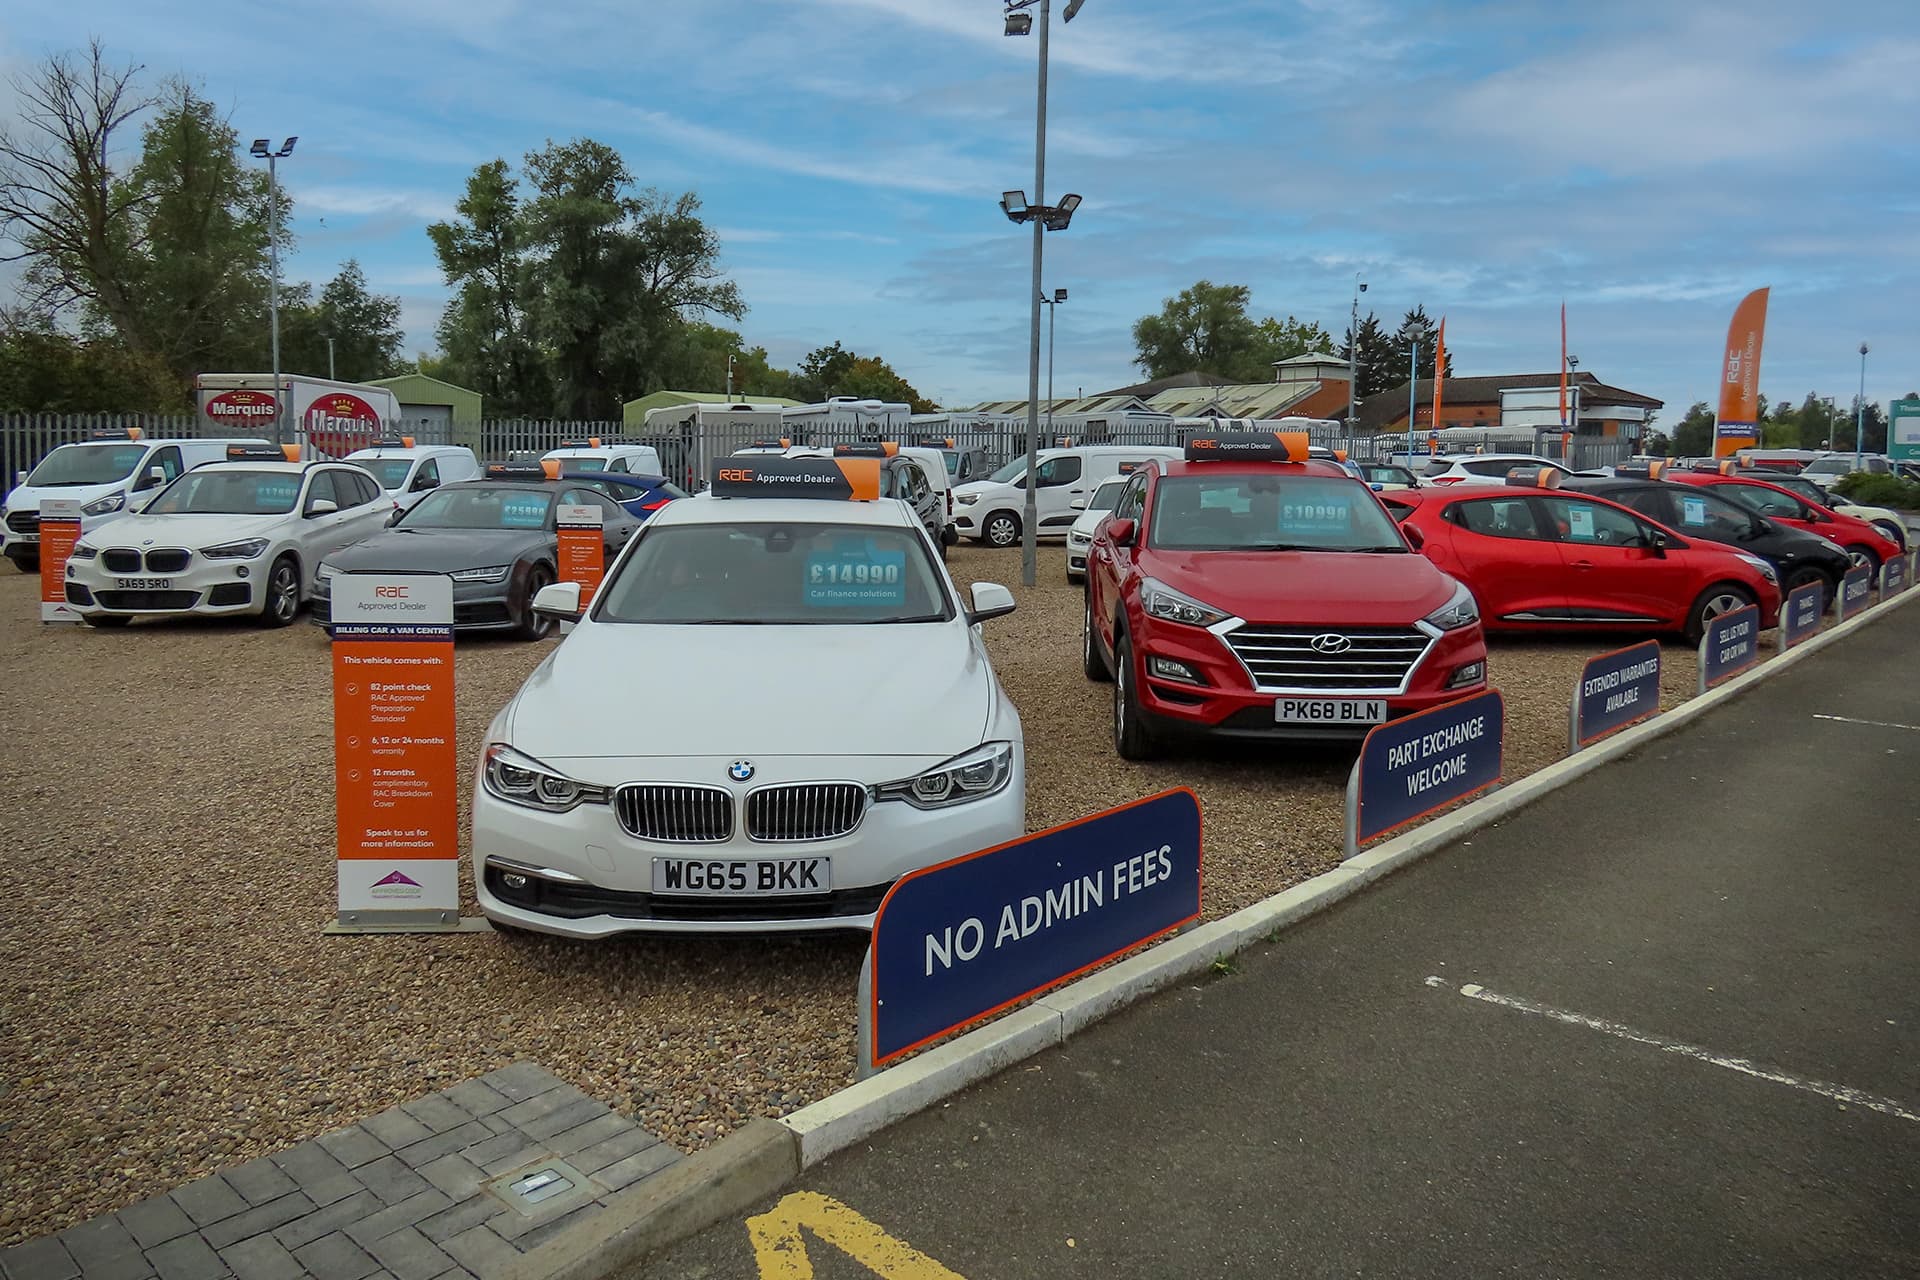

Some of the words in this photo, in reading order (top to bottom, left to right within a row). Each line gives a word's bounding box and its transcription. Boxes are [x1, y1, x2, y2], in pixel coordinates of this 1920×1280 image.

[212, 402, 275, 417] Marquis
[1219, 442, 1250, 450] Approved
[756, 473, 801, 484] Approved
[803, 473, 836, 483] Dealer
[810, 564, 898, 584] £14990
[118, 579, 145, 589] SA69
[810, 590, 824, 598] Car
[827, 590, 858, 598] finance
[859, 590, 897, 598] solutions
[357, 602, 398, 611] Approved
[400, 602, 427, 610] Dealer
[336, 626, 369, 634] BILLING
[343, 656, 361, 664] This
[363, 656, 392, 664] vehicle
[422, 657, 444, 665] with:
[1584, 671, 1620, 697] EXTENDED
[1620, 658, 1657, 684] WARRANTIES
[370, 683, 382, 691] 82
[383, 683, 405, 692] point
[406, 683, 432, 691] check
[370, 693, 388, 701] RAC
[389, 694, 425, 703] Approved
[1605, 686, 1639, 713] AVAILABLE
[370, 704, 415, 713] Preparation
[1282, 701, 1335, 720] PK68
[1340, 701, 1379, 720] BLN
[371, 714, 406, 722] Standard
[381, 736, 390, 744] 12
[402, 736, 413, 744] 24
[1388, 739, 1419, 771] PART
[1422, 715, 1485, 758] EXCHANGE
[372, 748, 405, 756] warranty
[1406, 752, 1467, 797] WELCOME
[372, 780, 429, 788] complimentary
[373, 800, 396, 808] Cover
[366, 829, 392, 838] Speak
[394, 829, 403, 837] to
[416, 829, 429, 837] for
[385, 839, 434, 848] information
[664, 860, 747, 890] WG65
[757, 860, 819, 890] BKK
[924, 917, 984, 977] NO
[994, 870, 1104, 948] ADMIN
[1113, 844, 1173, 900] FEES
